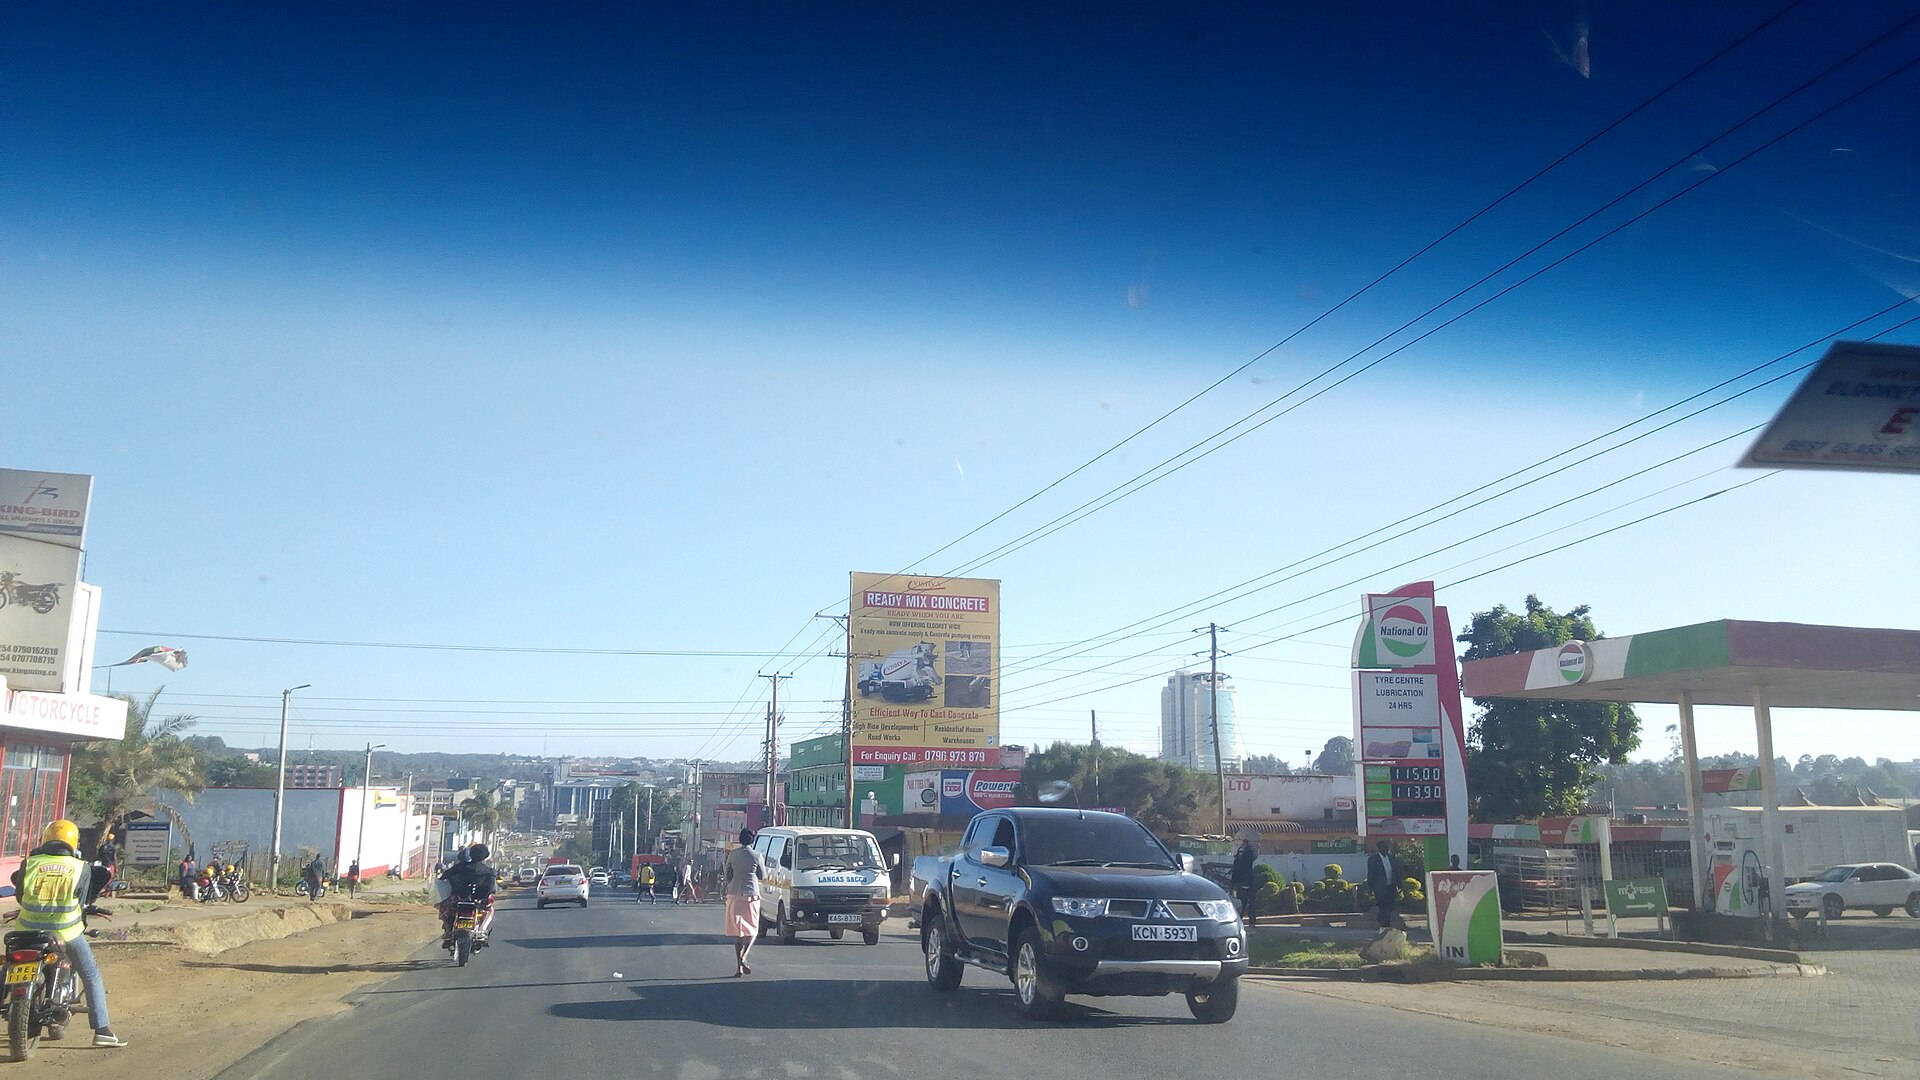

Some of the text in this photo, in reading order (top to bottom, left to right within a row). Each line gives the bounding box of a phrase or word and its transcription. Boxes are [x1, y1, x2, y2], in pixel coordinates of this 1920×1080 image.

[867, 593, 986, 611] READY MIX CONCRETE
[1380, 626, 1428, 636] National Oil
[1375, 676, 1424, 684] TYRE CENTRE
[1376, 689, 1424, 697] LUBRICATION
[4, 688, 101, 725] MOTORCYCLE
[870, 707, 979, 719] Efficient Way To Cast Concrete
[880, 723, 919, 731] Developments
[934, 725, 964, 733] Residential
[942, 736, 975, 744] Warehouses
[861, 751, 872, 760] For
[875, 751, 901, 761] Enquiry
[903, 752, 916, 760] Call
[924, 750, 947, 761] 0796
[949, 751, 966, 761] 973
[1396, 767, 1440, 781] 115.00
[1228, 779, 1251, 791] LTD
[1397, 785, 1441, 799] 113.90
[1133, 926, 1196, 940] KCN 593Y
[1446, 946, 1464, 958] IN
